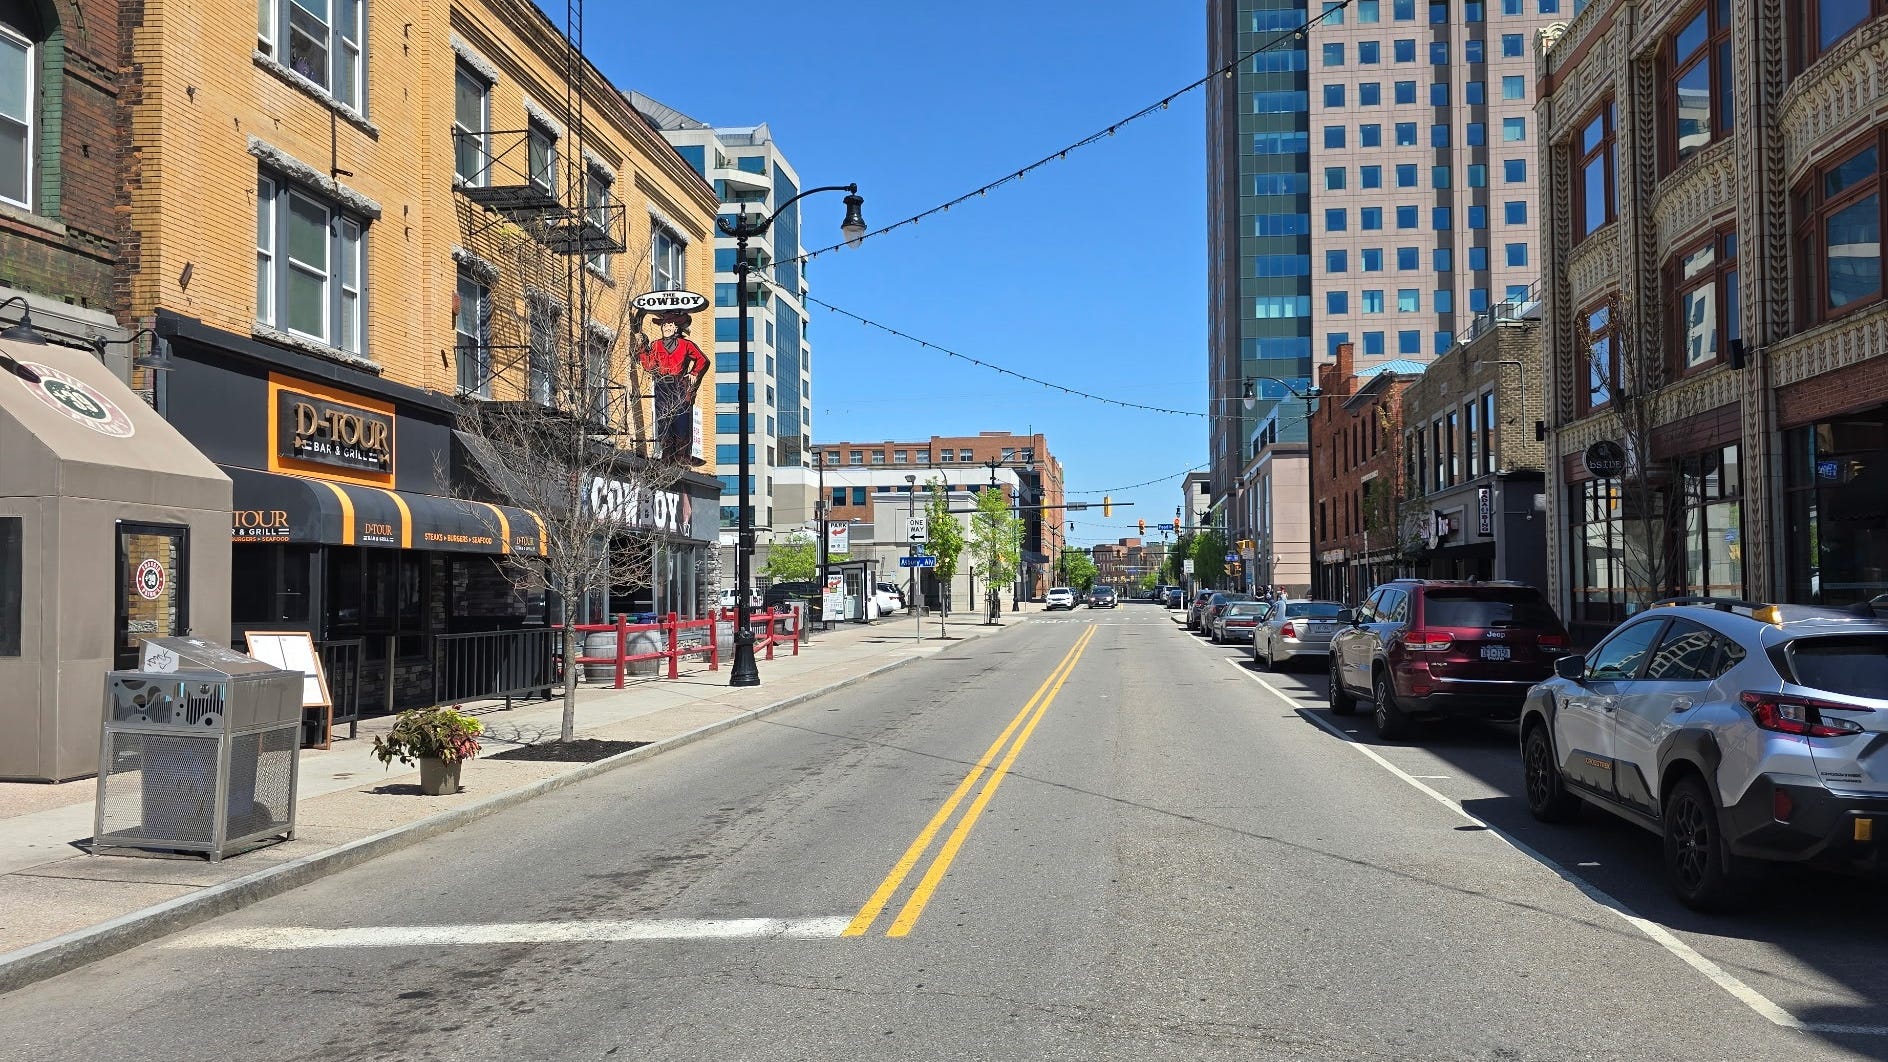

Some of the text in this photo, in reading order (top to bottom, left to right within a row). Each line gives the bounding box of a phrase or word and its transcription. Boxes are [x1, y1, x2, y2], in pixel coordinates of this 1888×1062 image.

[637, 296, 701, 307] COWBOY
[294, 402, 390, 452] D-TOUR
[313, 442, 368, 461] BAR & GRILL
[232, 510, 289, 528] TOUR
[239, 528, 245, 536] &
[249, 528, 277, 536] GRILL
[365, 523, 393, 536] D-TOUR
[424, 533, 443, 541] STEAKS
[447, 534, 468, 543] BURGERS
[1486, 630, 1506, 639] Jeep
